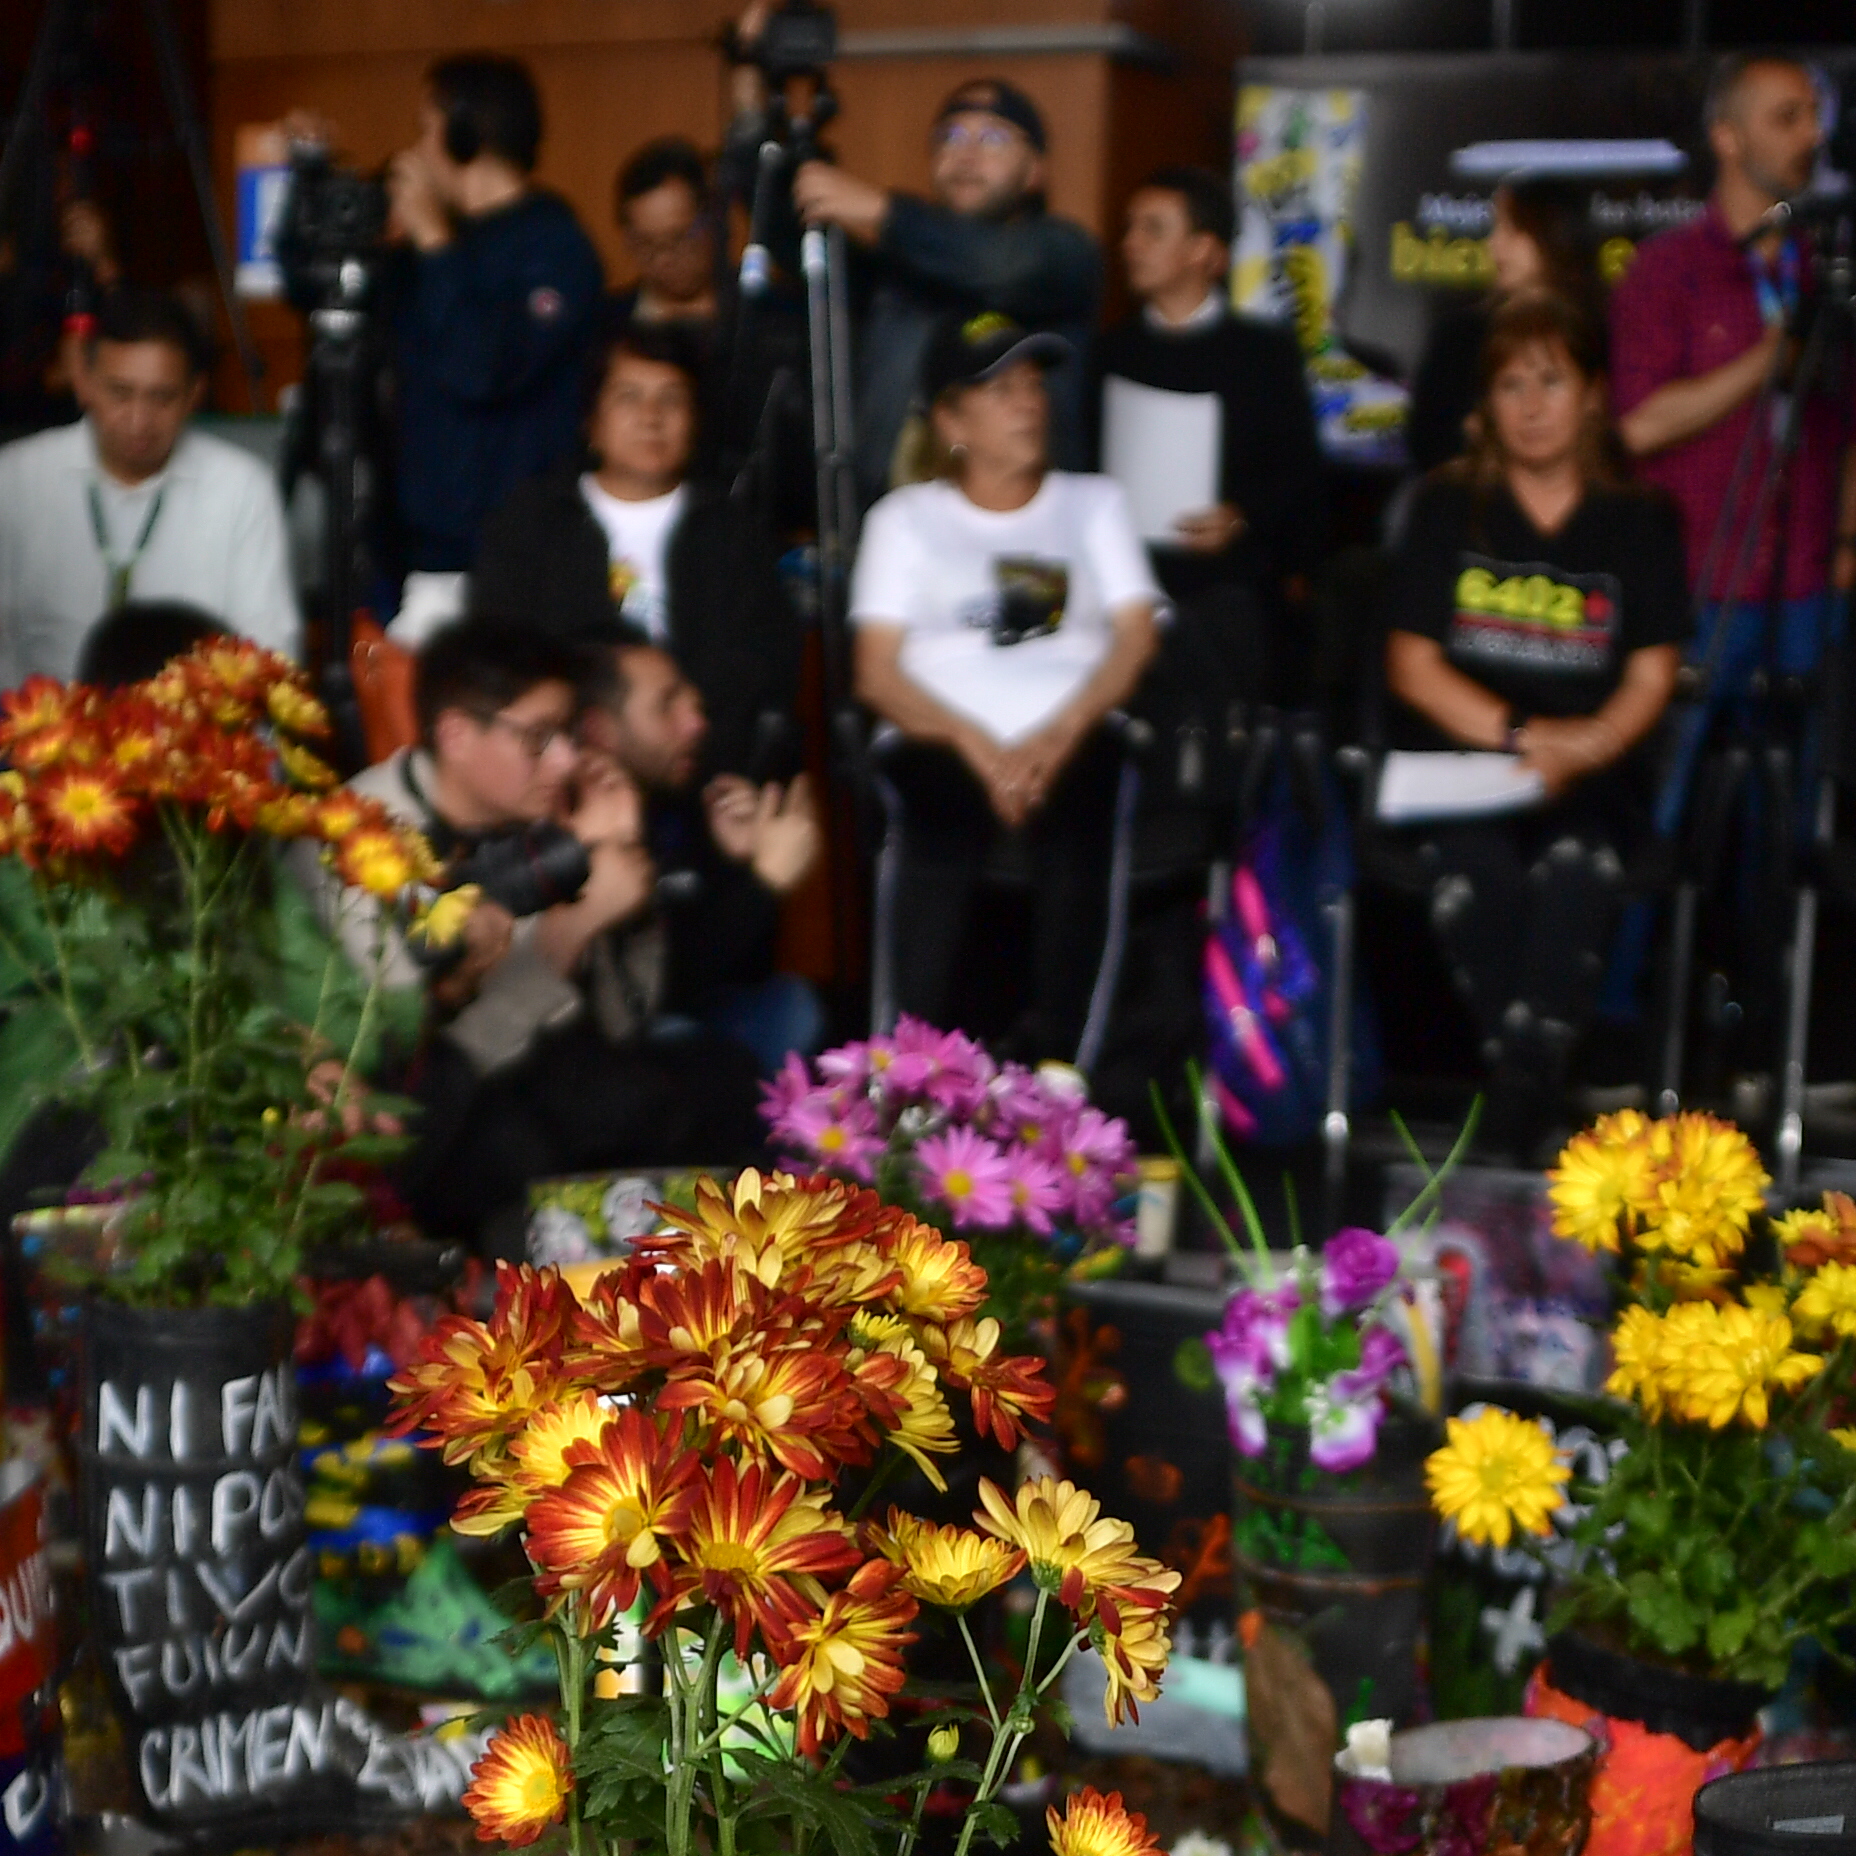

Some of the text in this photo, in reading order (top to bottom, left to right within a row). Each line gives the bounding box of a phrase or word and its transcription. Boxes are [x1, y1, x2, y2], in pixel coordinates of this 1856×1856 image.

[98, 1378, 187, 1464] NI
[104, 1482, 195, 1557] NI
[139, 1699, 330, 1812] CRIMEN
